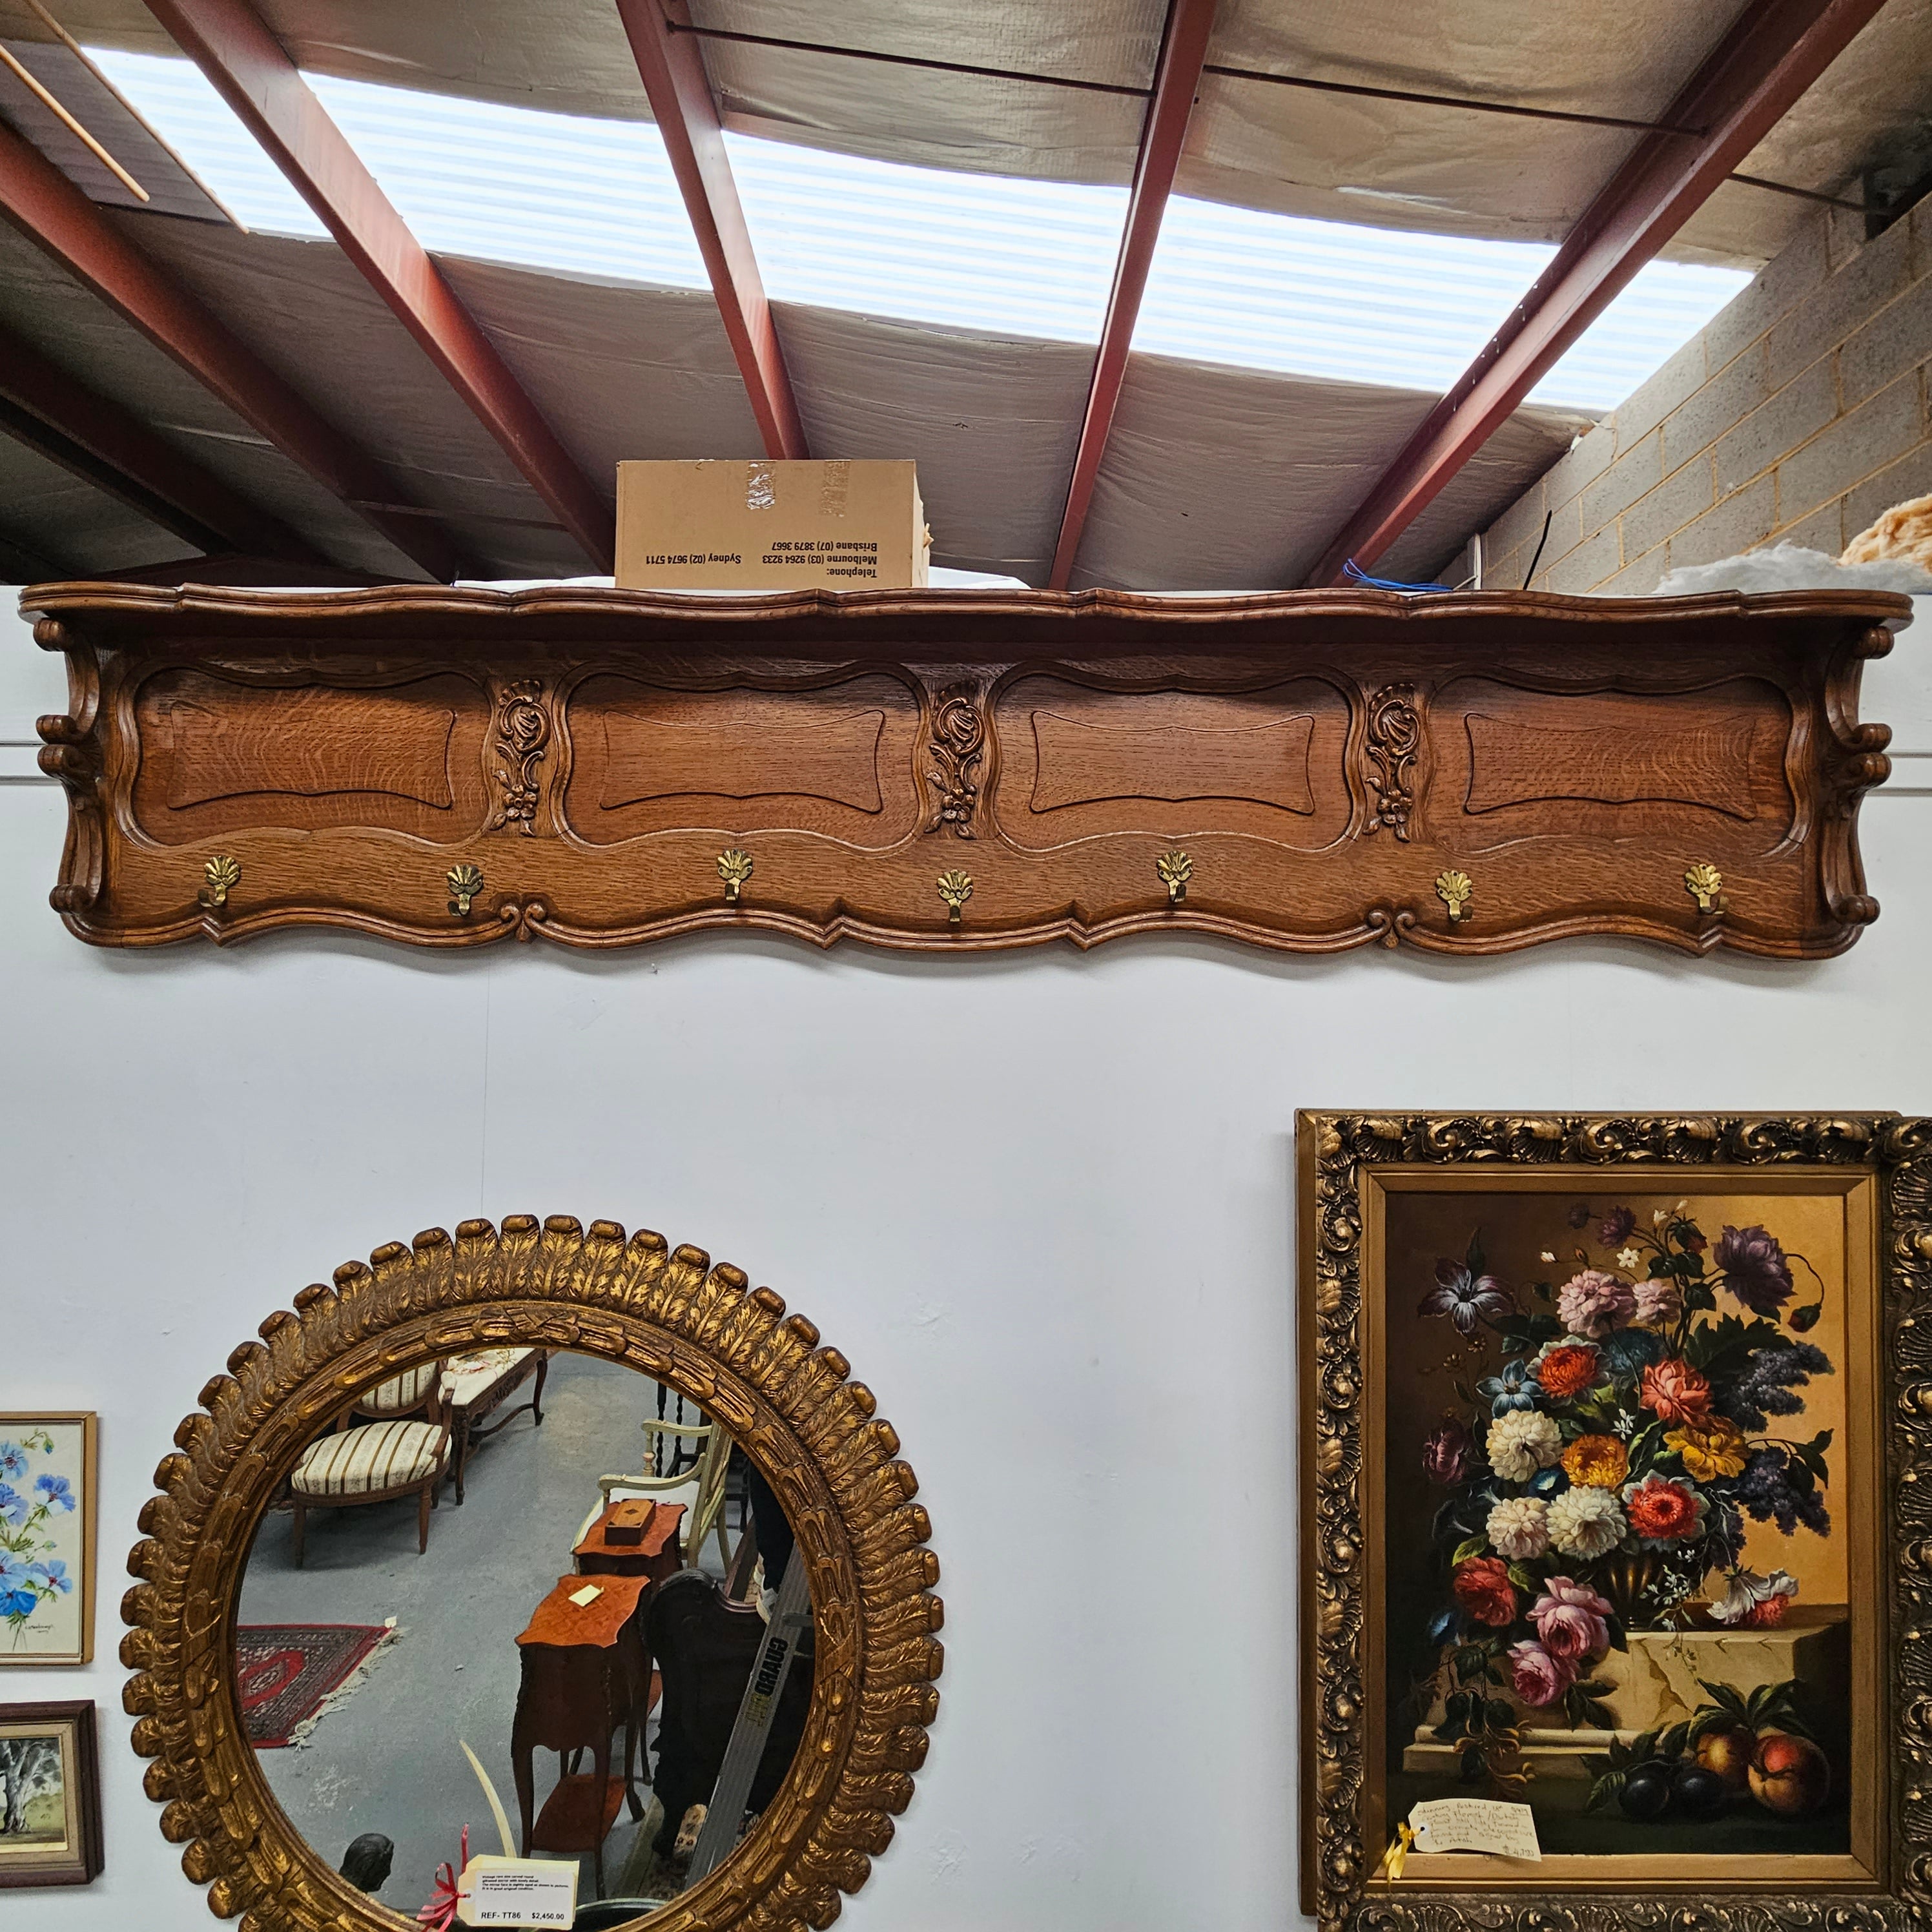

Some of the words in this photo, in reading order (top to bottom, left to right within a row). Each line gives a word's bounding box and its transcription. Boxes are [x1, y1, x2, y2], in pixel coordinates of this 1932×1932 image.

[772, 542, 792, 551] 3667
[794, 542, 815, 551] 3879
[817, 541, 834, 551] (07)
[836, 542, 878, 551] Brisbane
[646, 555, 666, 564] 5711
[667, 555, 688, 564] 9674
[690, 554, 706, 564] (02)
[708, 553, 741, 564] Sydney
[762, 555, 783, 564] 9233
[785, 555, 806, 564] 9264
[808, 554, 824, 564] (03)
[827, 555, 877, 565] Melbourne
[827, 566, 878, 578] Telephone:
